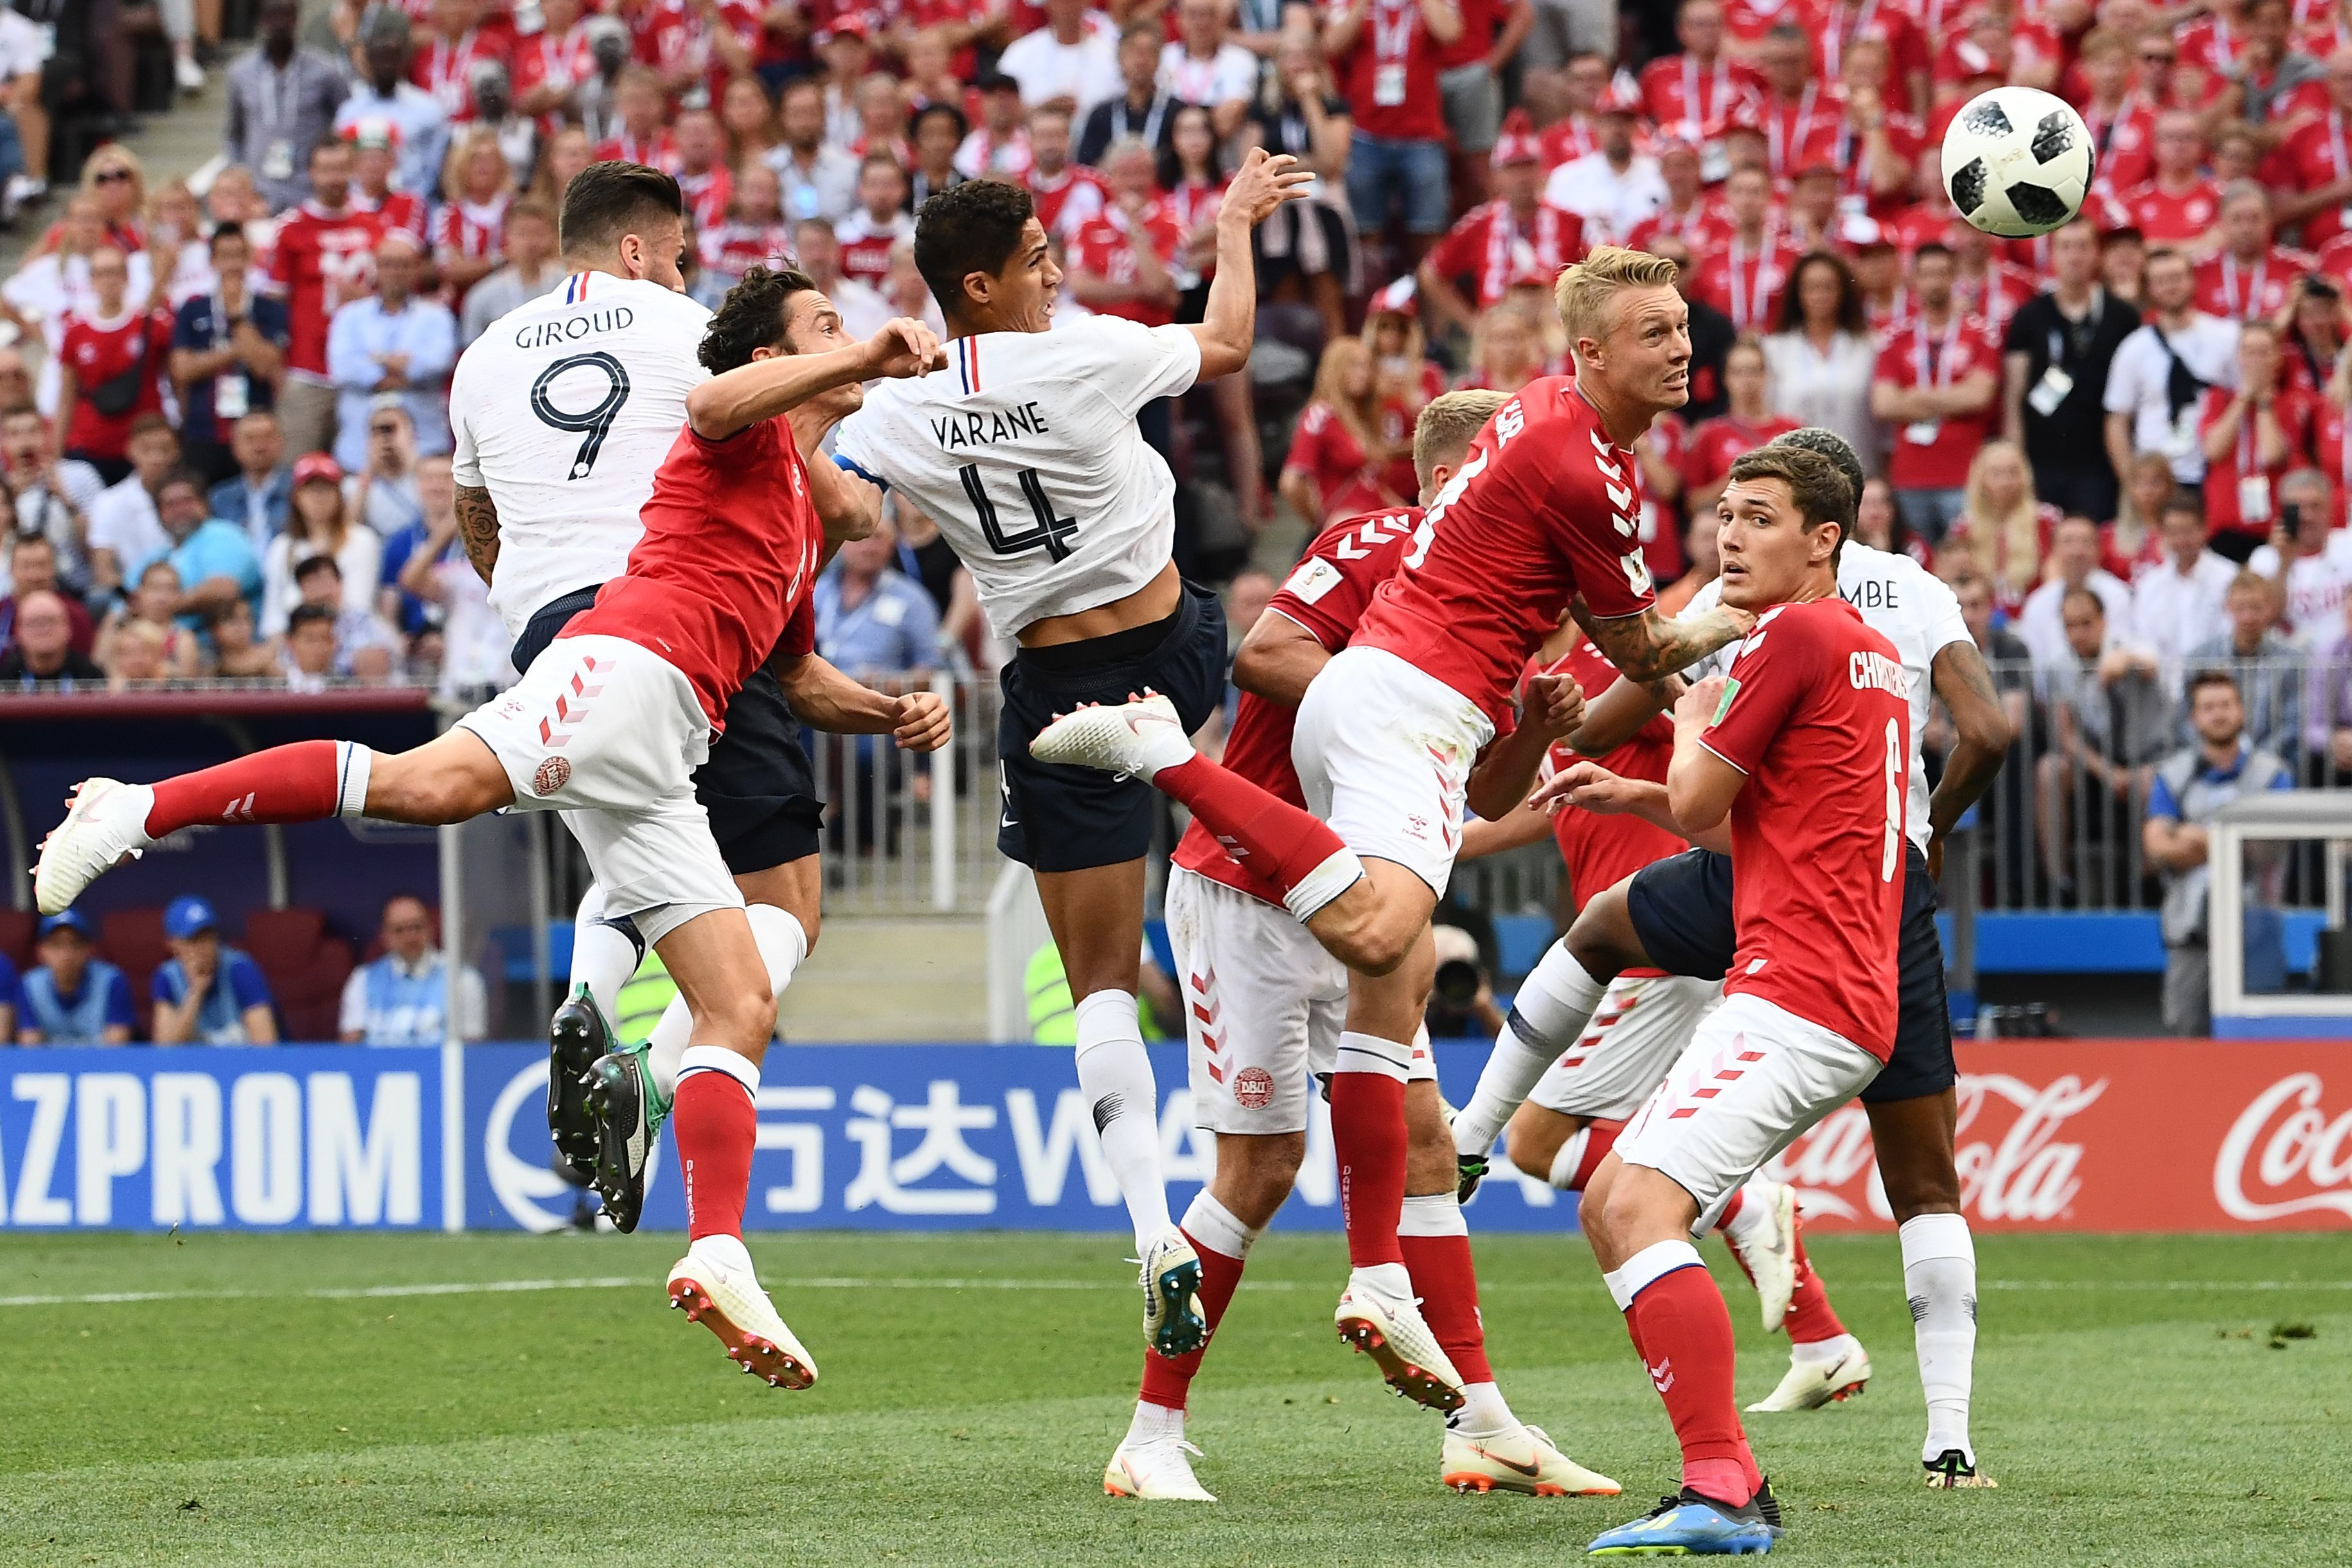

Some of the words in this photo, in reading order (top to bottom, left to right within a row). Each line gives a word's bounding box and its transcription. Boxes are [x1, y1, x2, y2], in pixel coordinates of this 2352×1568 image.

[515, 307, 634, 349] GIROUD
[530, 351, 631, 481] 9
[930, 401, 1049, 450] VARANE
[958, 463, 1080, 564] 4
[0, 1071, 423, 1225] ZPROM
